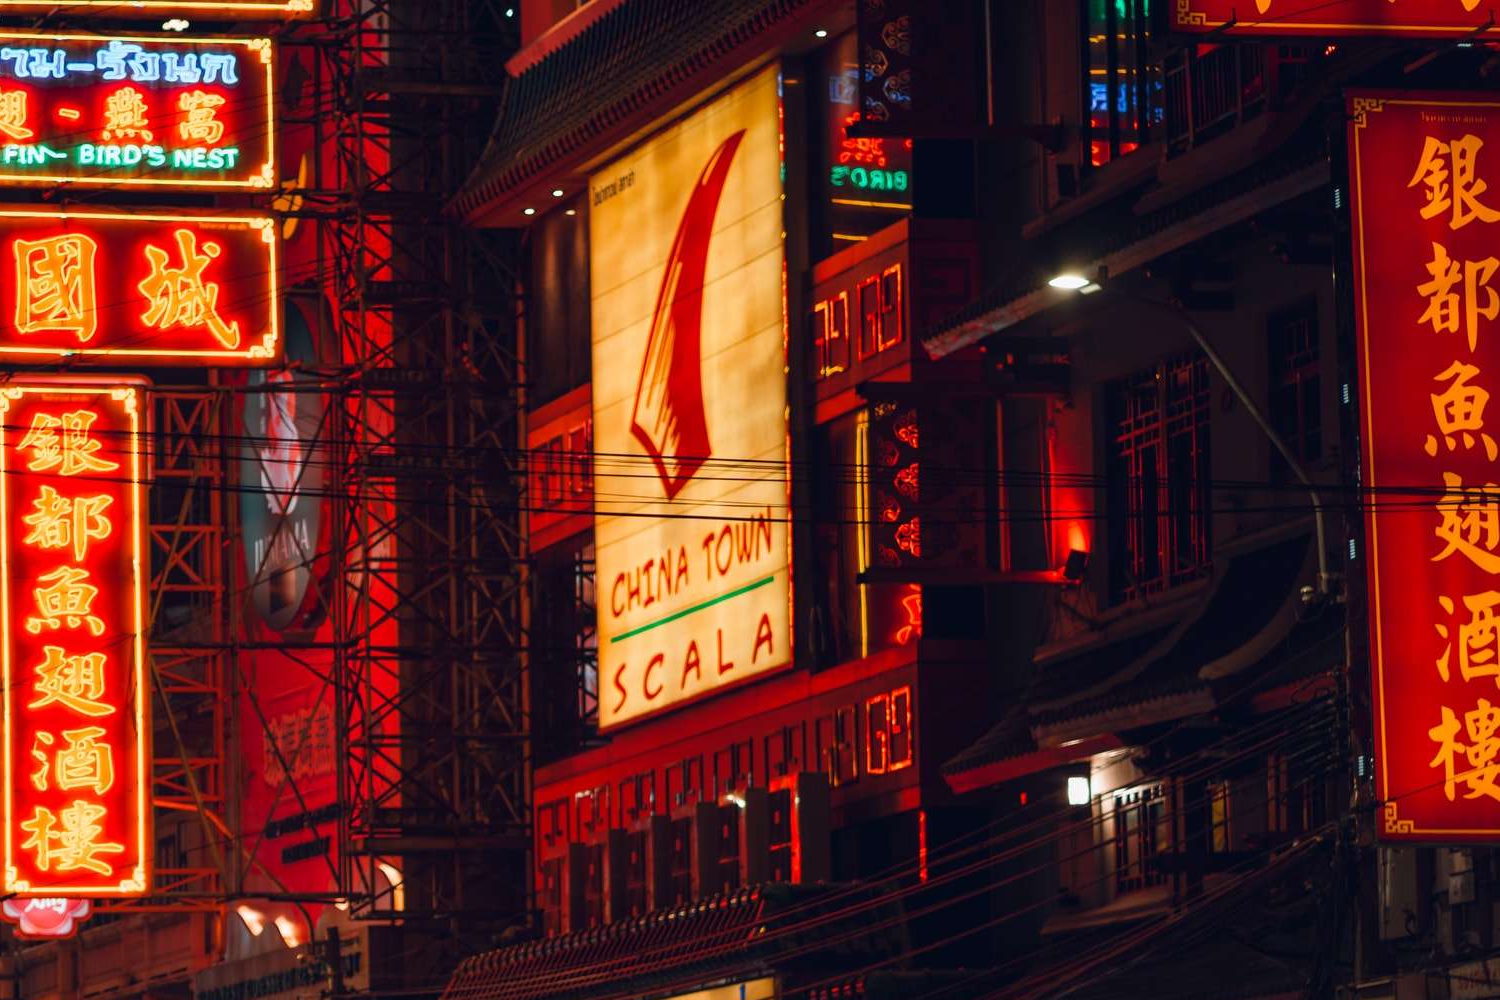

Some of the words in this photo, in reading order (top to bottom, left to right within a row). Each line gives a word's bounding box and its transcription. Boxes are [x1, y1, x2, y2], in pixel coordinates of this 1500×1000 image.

[80, 143, 166, 167] BIRD'S
[174, 149, 239, 169] NEST
[611, 548, 688, 619] CHINA
[702, 506, 772, 579] TOWN
[17, 409, 124, 877] 銀都魚翅酒樓
[611, 612, 774, 715] SCALA
